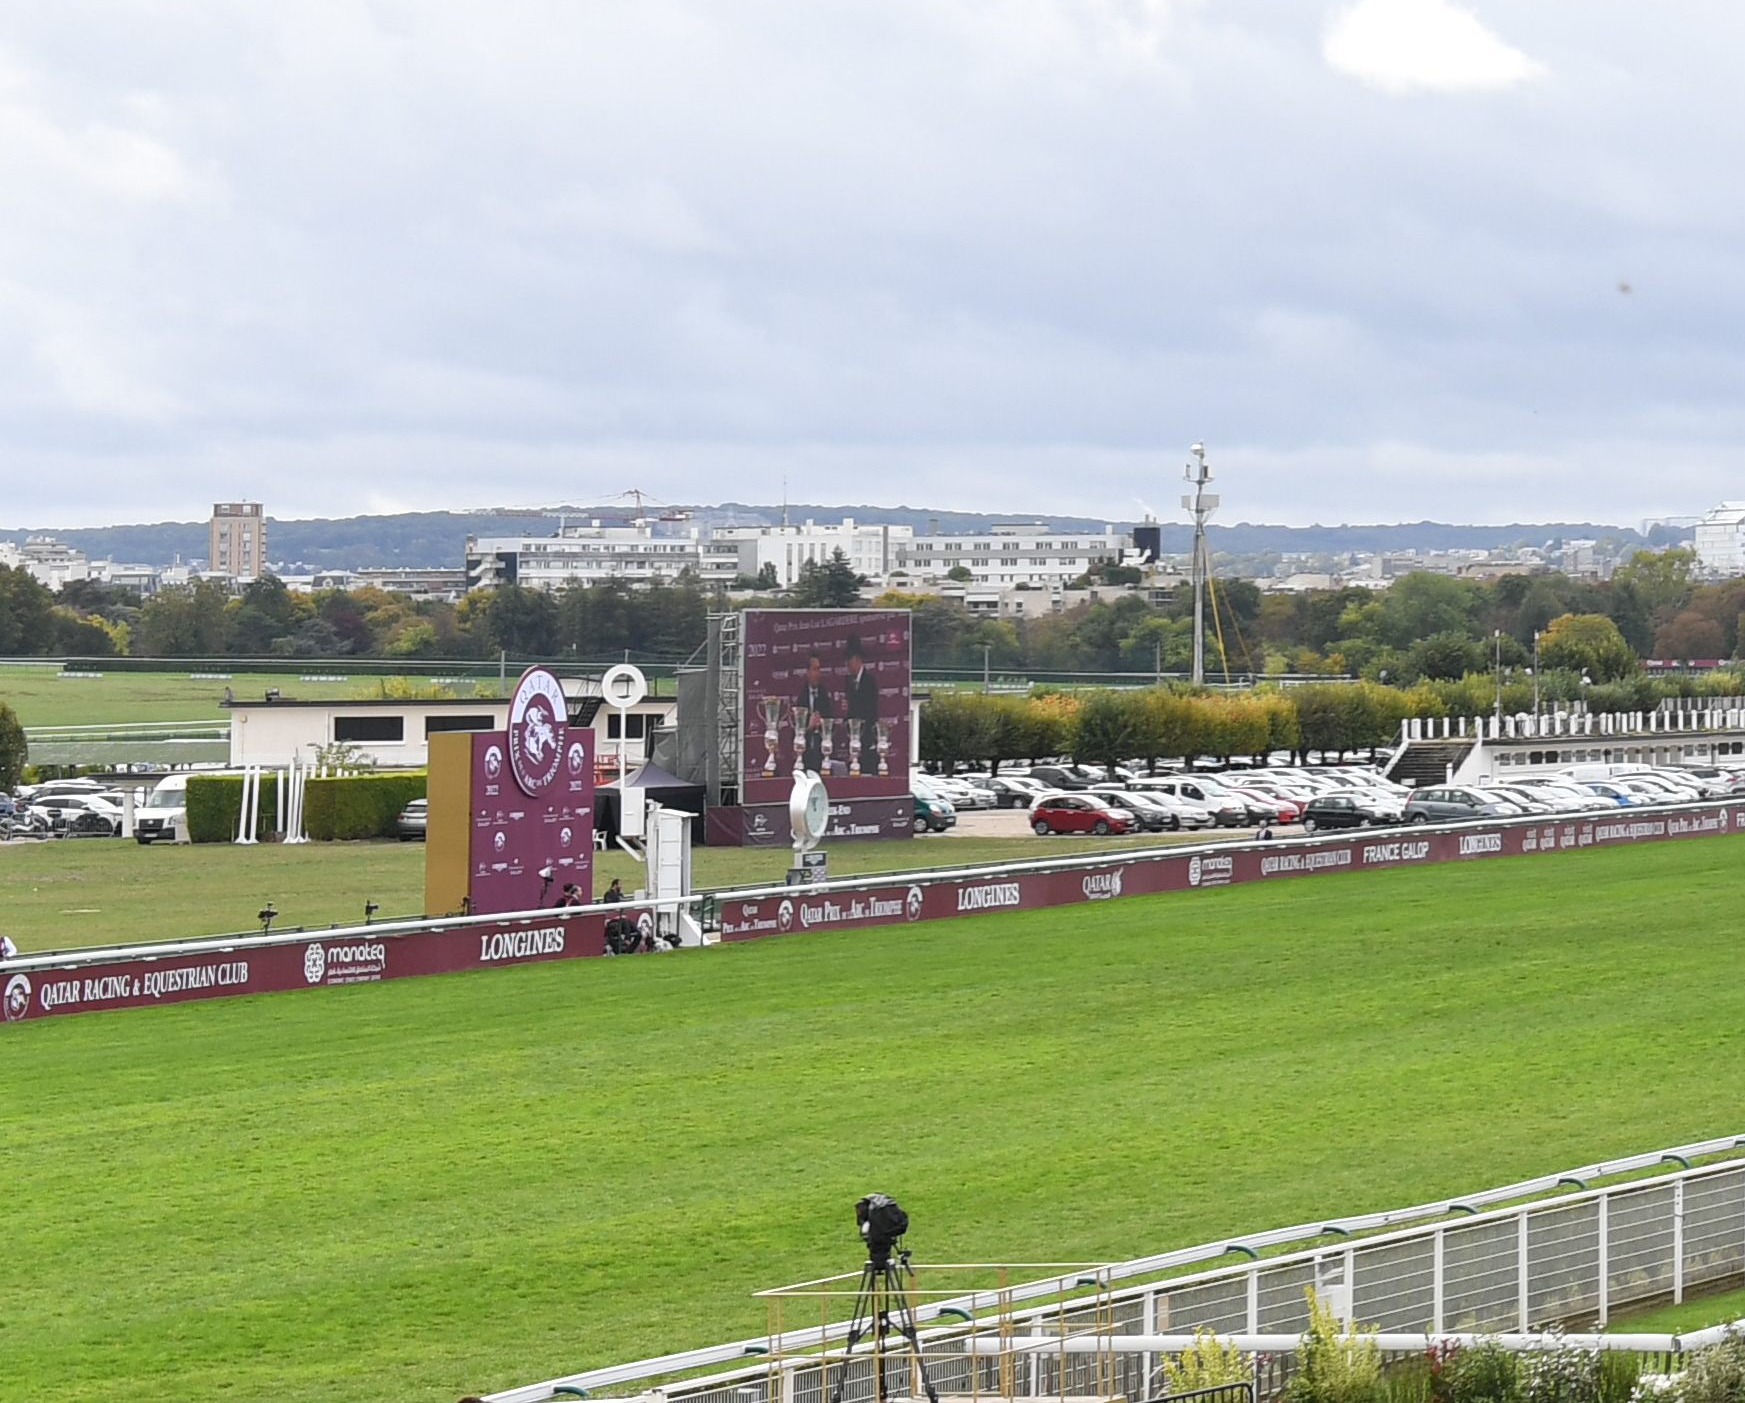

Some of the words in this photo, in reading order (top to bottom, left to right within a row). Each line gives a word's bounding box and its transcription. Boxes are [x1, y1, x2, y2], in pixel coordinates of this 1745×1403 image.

[519, 674, 559, 705] QATAR
[1363, 843, 1400, 863] FRANCE
[1401, 841, 1429, 859] GALOP
[957, 883, 1020, 911] LONGINES
[1083, 873, 1112, 894] QATAR
[328, 942, 385, 969] manateq
[480, 927, 564, 961] LONGINES
[41, 980, 81, 1010] QATAR
[84, 974, 131, 1001] RACING
[133, 978, 140, 996] &
[143, 964, 217, 998] EQUESTRIAN
[217, 961, 248, 985] CLUB
